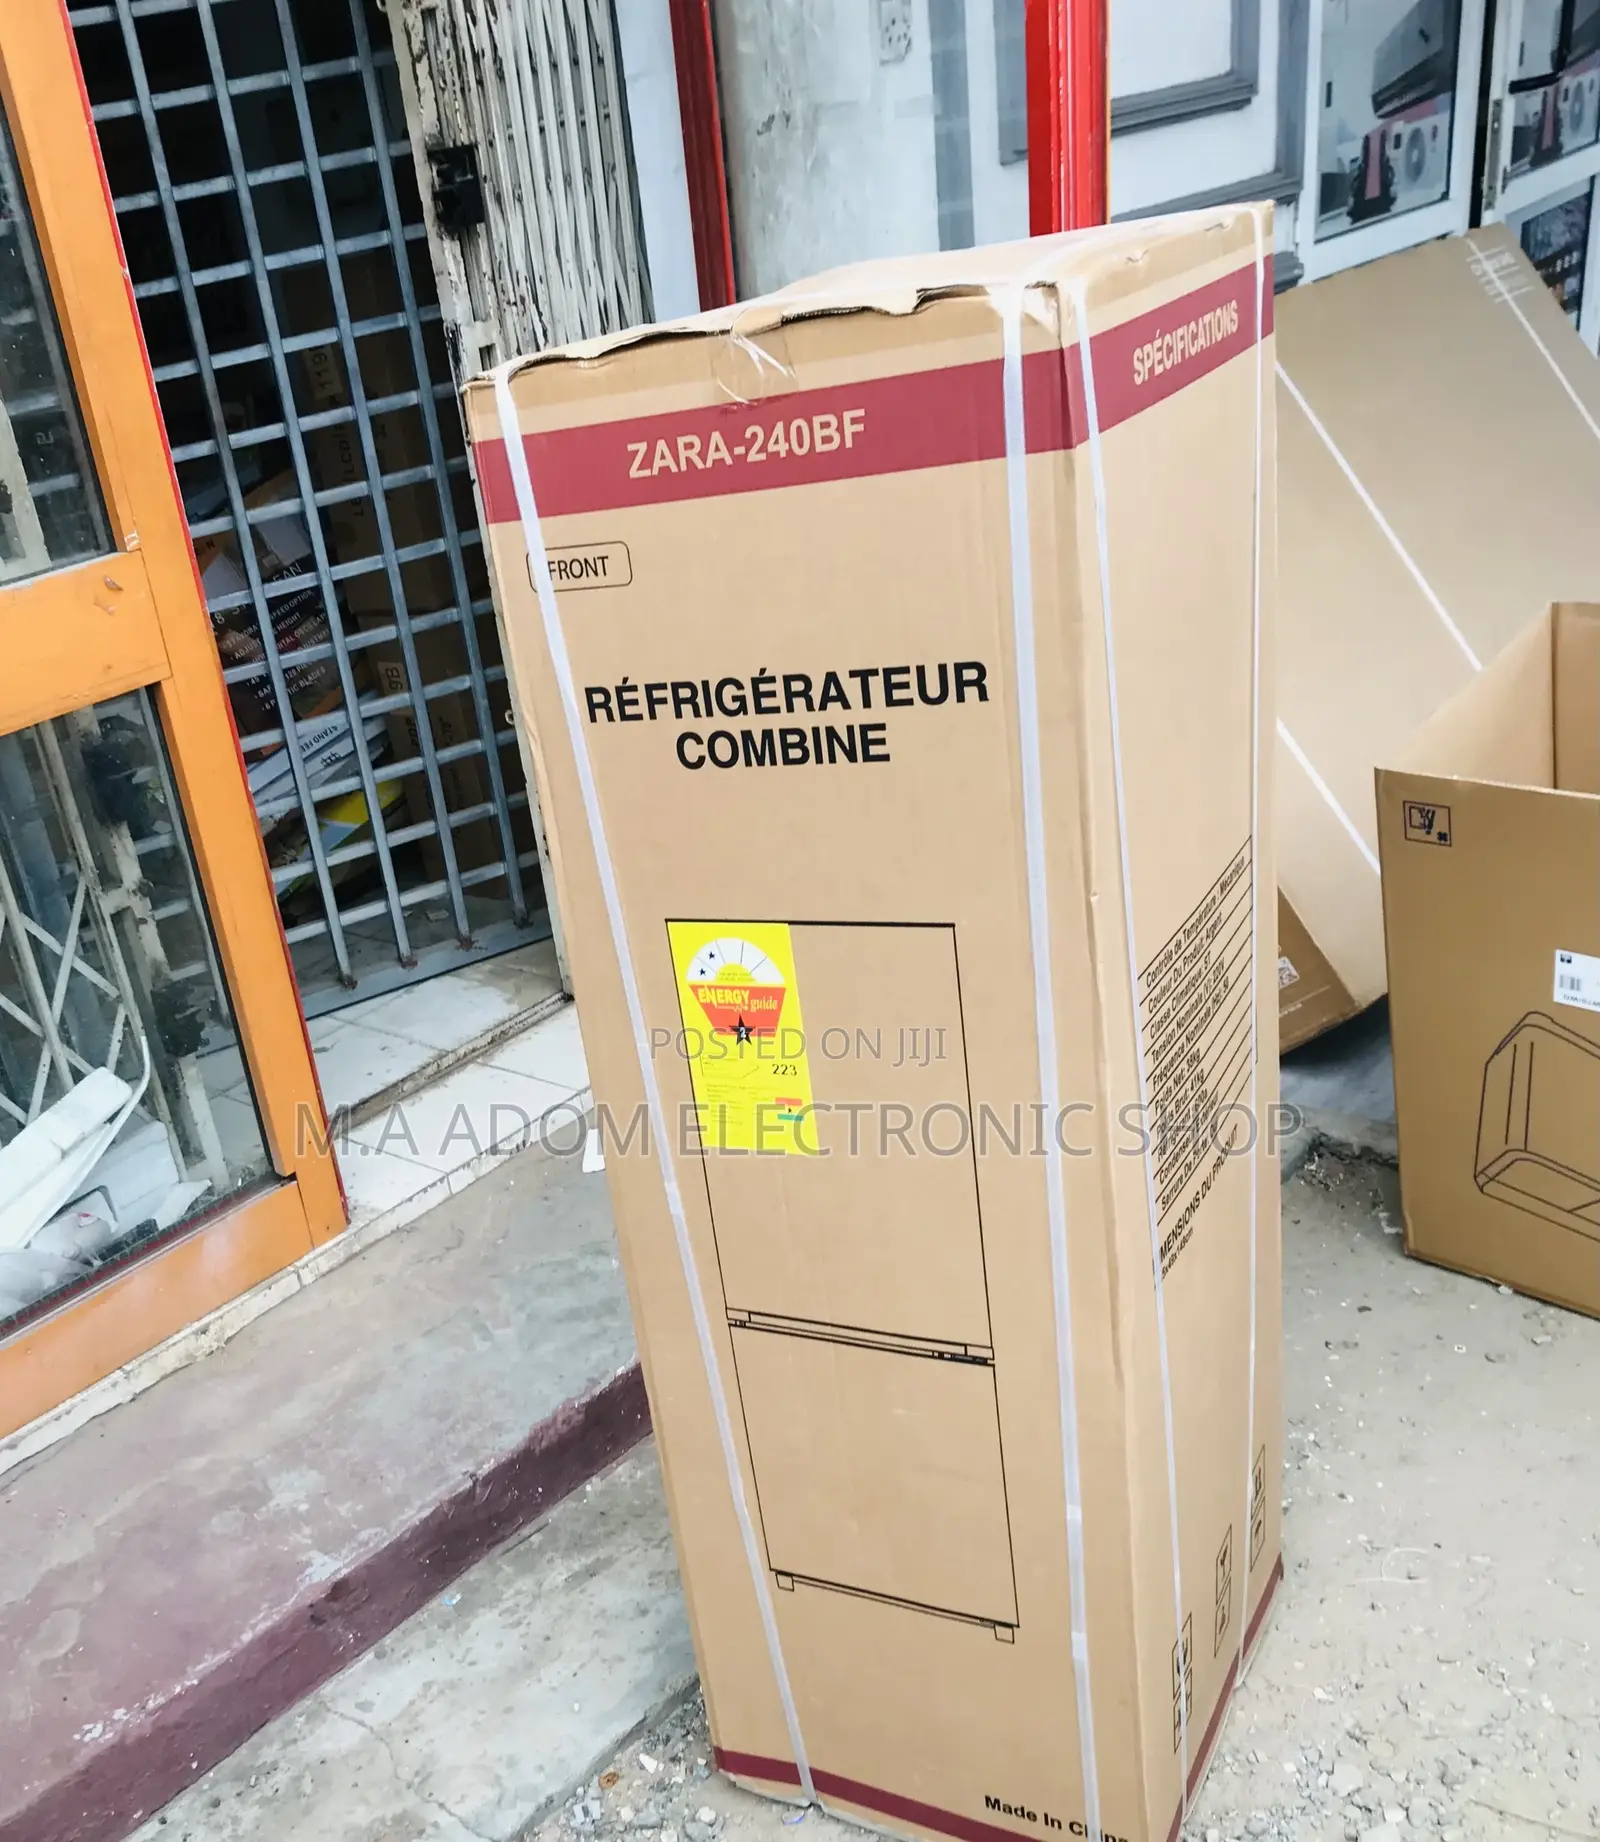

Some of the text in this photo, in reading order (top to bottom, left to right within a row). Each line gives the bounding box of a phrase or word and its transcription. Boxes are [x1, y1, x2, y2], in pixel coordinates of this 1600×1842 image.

[1133, 299, 1239, 386] SPÉCIFICATIONS
[627, 408, 866, 479] ZARA-240BF
[546, 555, 610, 581] FRONT
[584, 661, 990, 723] RÉFRIGÉRATEUR
[676, 722, 891, 771] COMBINE
[1146, 948, 1173, 988] Contrôle
[1173, 939, 1182, 955] de
[1182, 894, 1216, 944] Température
[1148, 977, 1173, 1014] Couleur
[1173, 965, 1182, 983] Du
[1205, 911, 1222, 941] Argent
[698, 987, 778, 1013] ENERGY guide
[1150, 1007, 1171, 1040] Classe
[1204, 950, 1211, 970] ST
[739, 1027, 747, 1039] 2
[1151, 1028, 1176, 1065] Tension
[1176, 992, 1203, 1034] Nominale
[1153, 1042, 1185, 1091] Fréquence
[1185, 1006, 1211, 1049] Nominale
[772, 1063, 798, 1077] 223
[1154, 1085, 1173, 1116] Poids
[1173, 1068, 1185, 1091] Net:
[1156, 1112, 1175, 1140] Poids
[1190, 1068, 1204, 1091] 41kg
[1159, 1123, 1238, 1263] MENSIONS DU PRODUIT
[1161, 1172, 1184, 1212] Serrure
[1183, 1159, 1194, 1180] De
[984, 1794, 1038, 1823] Made
[1043, 1812, 1062, 1831] In
